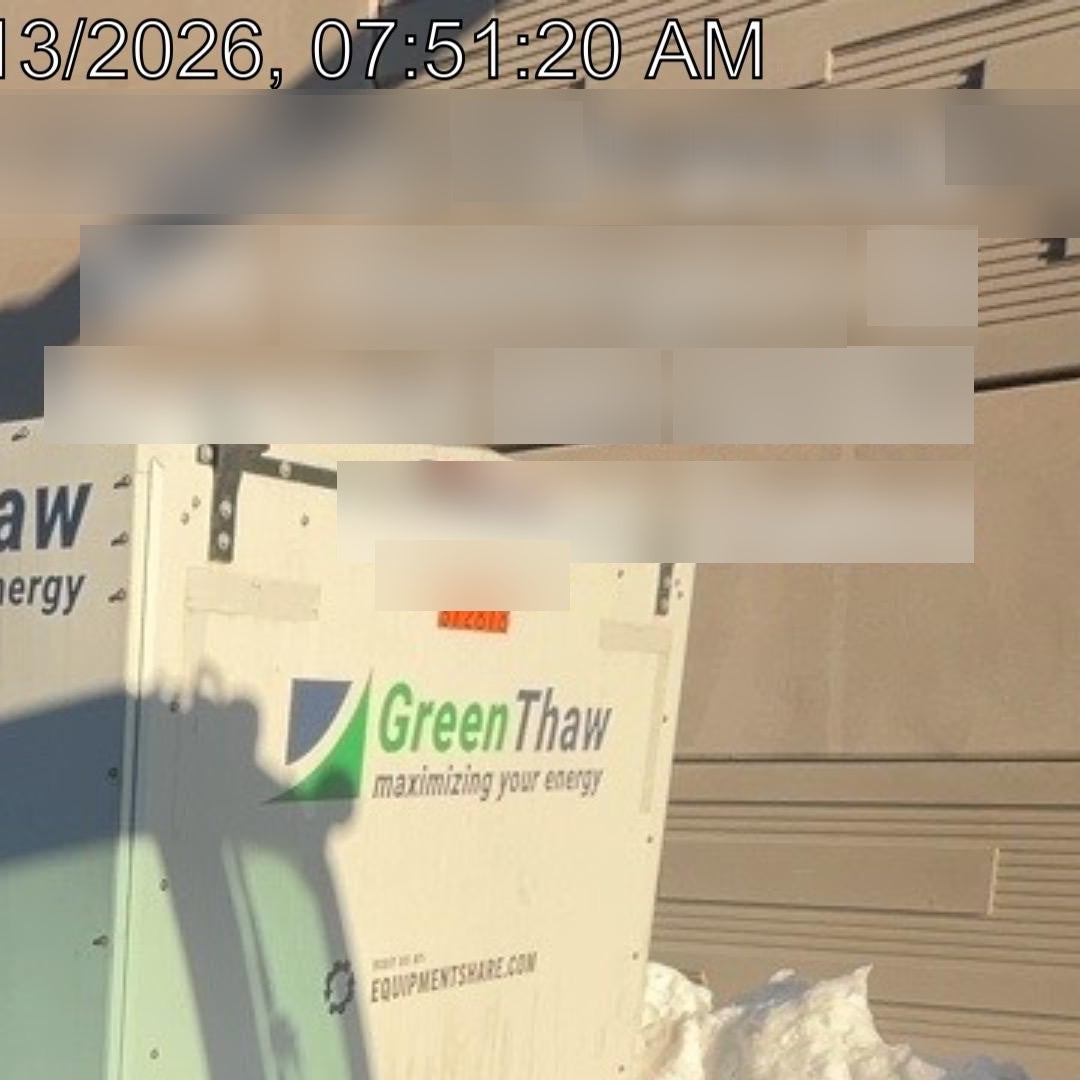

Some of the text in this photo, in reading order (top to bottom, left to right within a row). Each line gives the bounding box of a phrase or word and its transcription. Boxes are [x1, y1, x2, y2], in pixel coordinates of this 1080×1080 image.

[371, 764, 604, 802] maximizing your energy
[371, 952, 537, 1002] EQUIPMENTSHARE.COM
